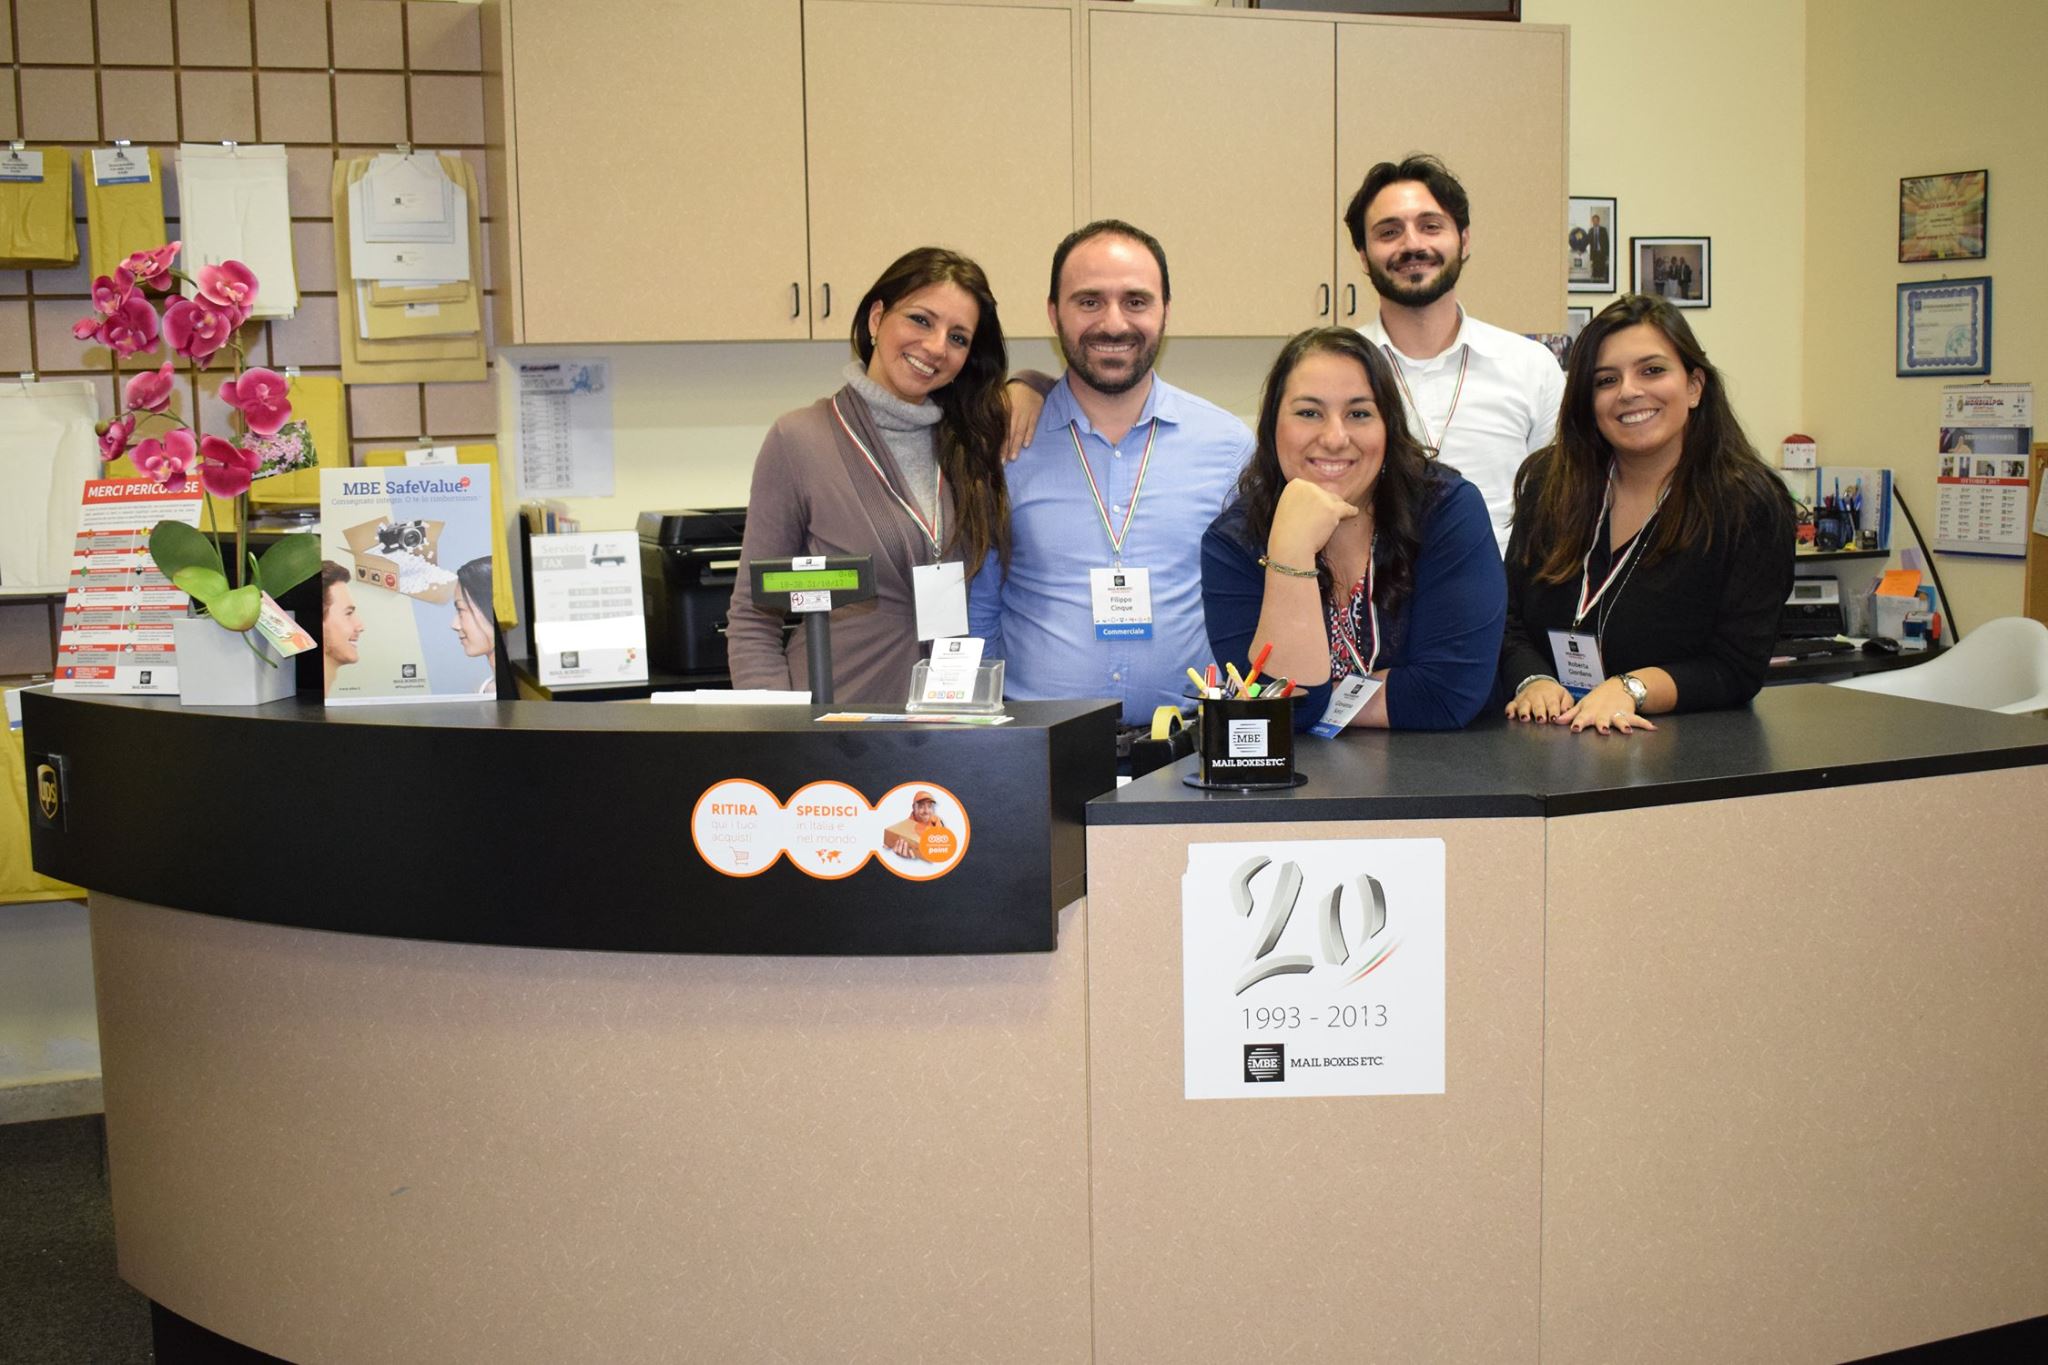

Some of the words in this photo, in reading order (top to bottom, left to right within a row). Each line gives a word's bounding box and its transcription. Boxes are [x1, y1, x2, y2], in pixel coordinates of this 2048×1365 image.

[88, 485, 123, 498] MERCI
[125, 481, 199, 496] PERICOSE
[343, 482, 381, 495] MBE
[542, 558, 564, 569] FAX
[1237, 734, 1261, 743] MBE
[1212, 759, 1236, 767] MAIL
[1236, 758, 1266, 767] BOXES
[711, 803, 758, 816] RITIRA
[796, 804, 858, 817] SPEDISCI
[815, 833, 857, 845] mondo
[1228, 855, 1387, 997] 20
[1242, 1006, 1301, 1030] 1993
[1327, 1004, 1389, 1028] 2013
[1252, 1058, 1278, 1069] MBE
[1290, 1058, 1322, 1067] MAIL
[1323, 1057, 1359, 1067] BOXES
